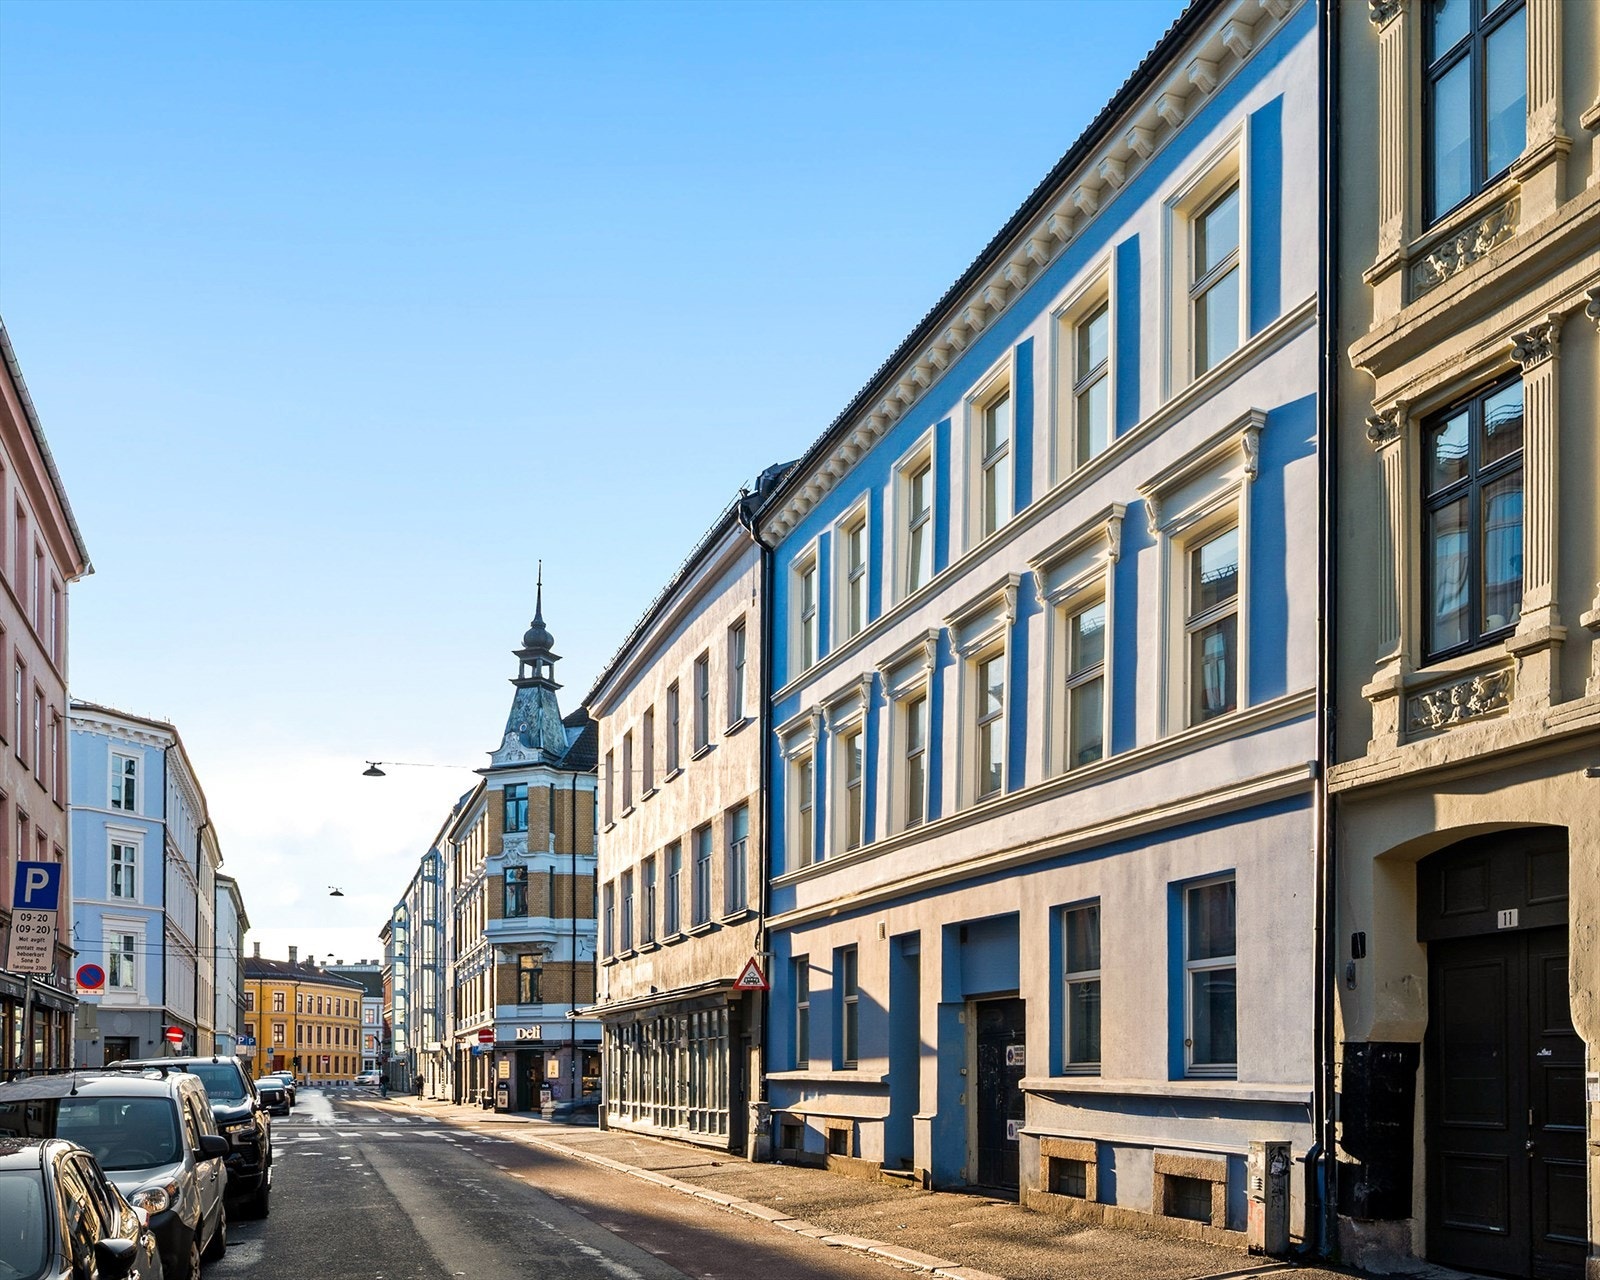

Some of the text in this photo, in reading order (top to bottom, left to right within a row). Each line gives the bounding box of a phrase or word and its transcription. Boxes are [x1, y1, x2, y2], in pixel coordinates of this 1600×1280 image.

[24, 867, 49, 903] P
[1503, 911, 1512, 926] 11
[516, 1024, 541, 1039] Deli
[238, 1036, 244, 1044] P
[248, 1037, 254, 1045] P
